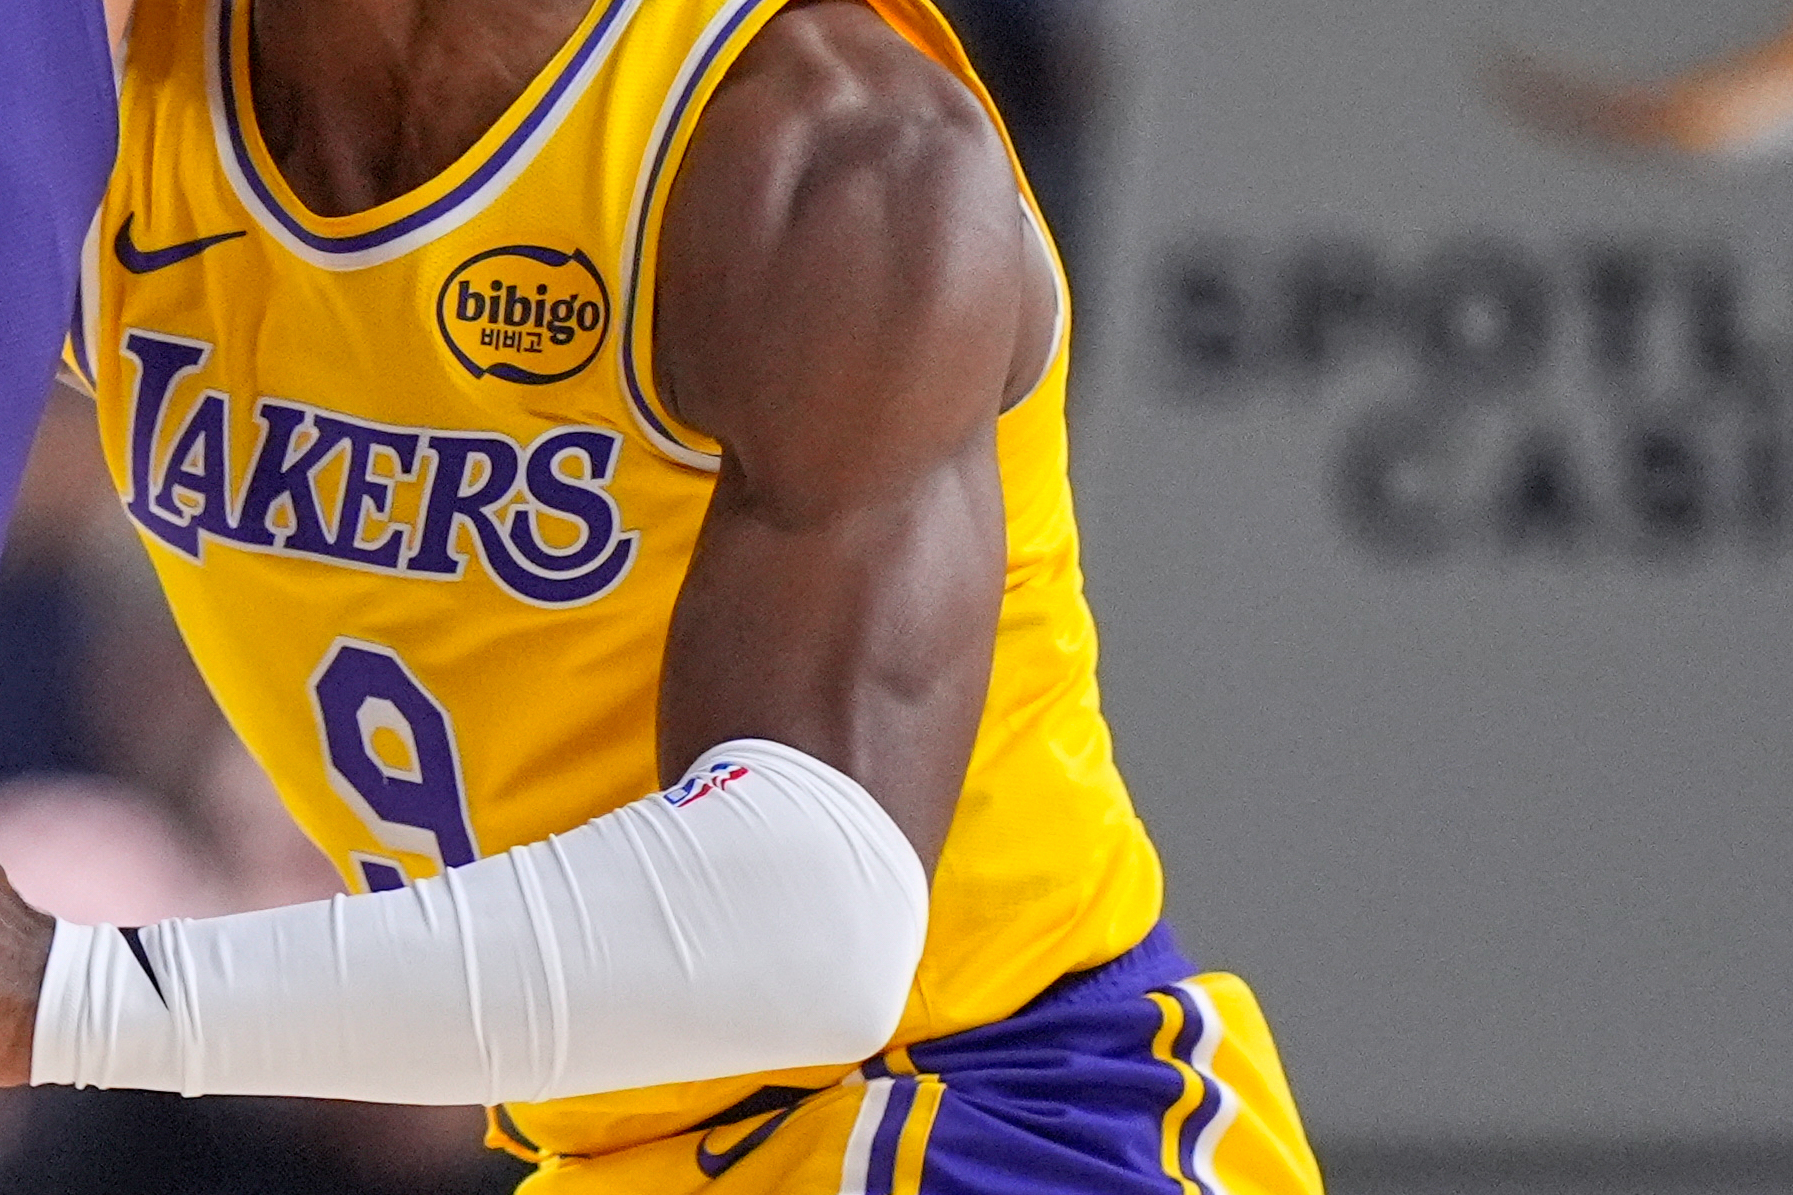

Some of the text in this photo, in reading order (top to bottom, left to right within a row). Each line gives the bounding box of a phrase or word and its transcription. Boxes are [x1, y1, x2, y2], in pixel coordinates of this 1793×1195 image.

[455, 279, 601, 346] bibigo
[479, 327, 544, 354] 비비고
[122, 329, 639, 608] LAKERS
[310, 636, 481, 892] 9
